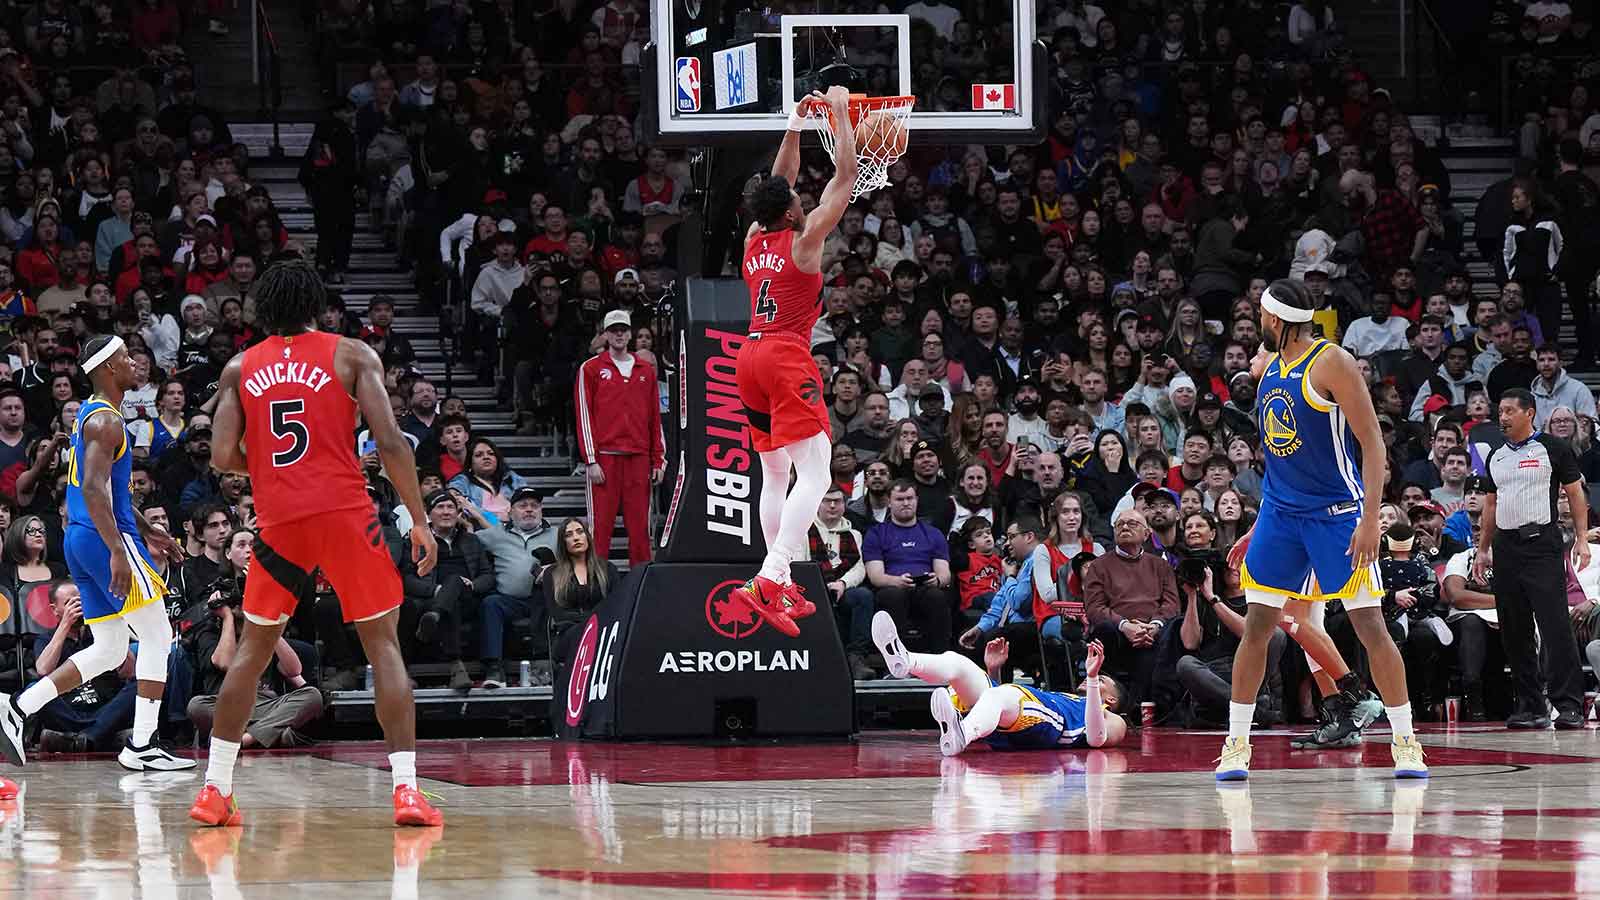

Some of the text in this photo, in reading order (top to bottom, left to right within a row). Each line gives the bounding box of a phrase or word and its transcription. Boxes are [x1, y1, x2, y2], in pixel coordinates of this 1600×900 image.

[726, 49, 745, 105] Bell
[680, 99, 692, 108] NBA
[746, 253, 785, 276] BARNES
[755, 279, 777, 322] 4
[244, 362, 332, 397] QUICKLEY
[1262, 388, 1295, 407] GOLDEN STATE
[1282, 409, 1290, 424] 4
[270, 399, 310, 467] 5
[1263, 435, 1302, 457] WARRIORS
[588, 620, 619, 702] LG
[659, 650, 809, 673] AEROPLAN
